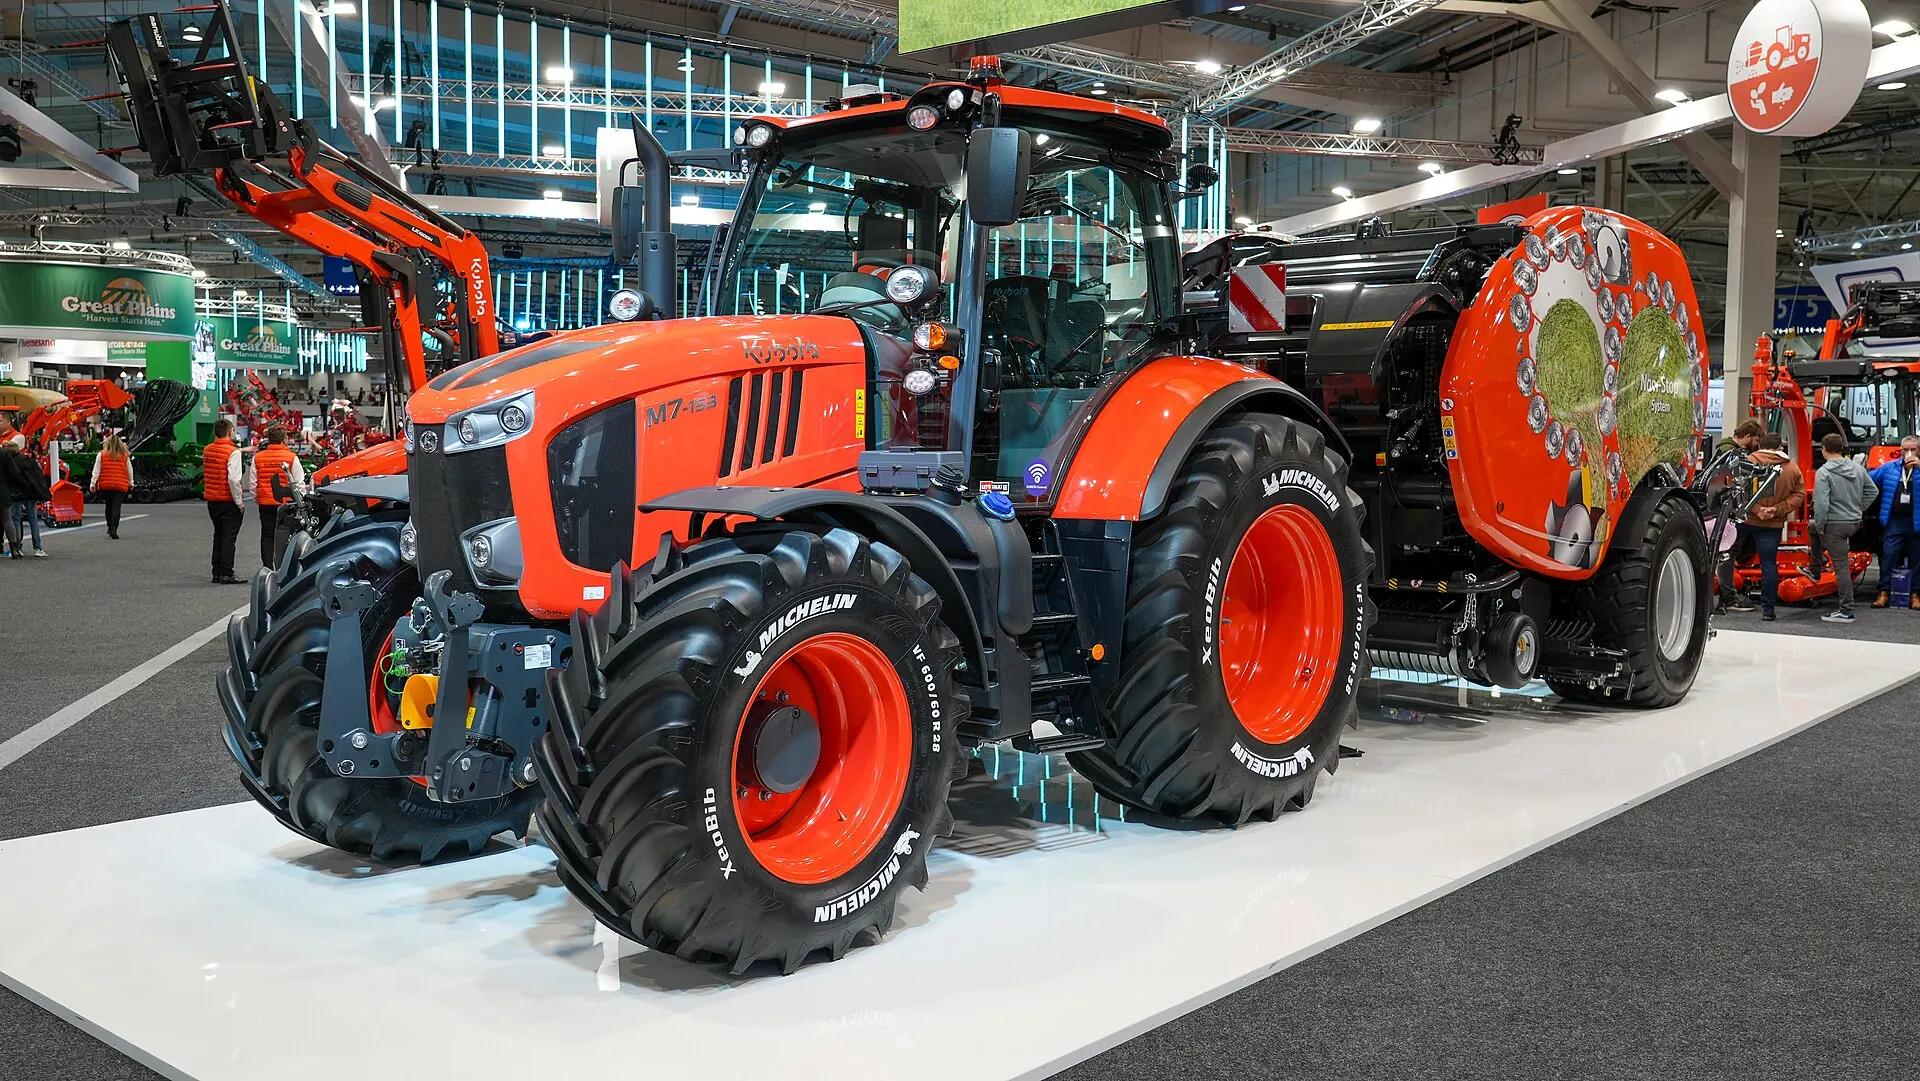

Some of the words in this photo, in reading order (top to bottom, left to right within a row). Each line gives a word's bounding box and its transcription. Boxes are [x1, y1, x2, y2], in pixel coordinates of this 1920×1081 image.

[471, 258, 488, 316] Kubota
[61, 296, 124, 315] Great
[126, 300, 176, 320] Plains
[1806, 298, 1819, 318] 5
[220, 339, 261, 352] Great
[262, 341, 291, 355] Plains
[741, 337, 819, 364] Kubota
[1640, 374, 1679, 398] Non-Stop
[646, 395, 718, 428] M7-153
[1279, 469, 1341, 512] MICHELIN
[759, 594, 858, 652] MICHELIN
[1203, 557, 1222, 666] XeoBib
[1230, 742, 1298, 778] MICHELIN
[704, 788, 737, 880] XeoBib
[814, 855, 901, 923] MICHELIN
